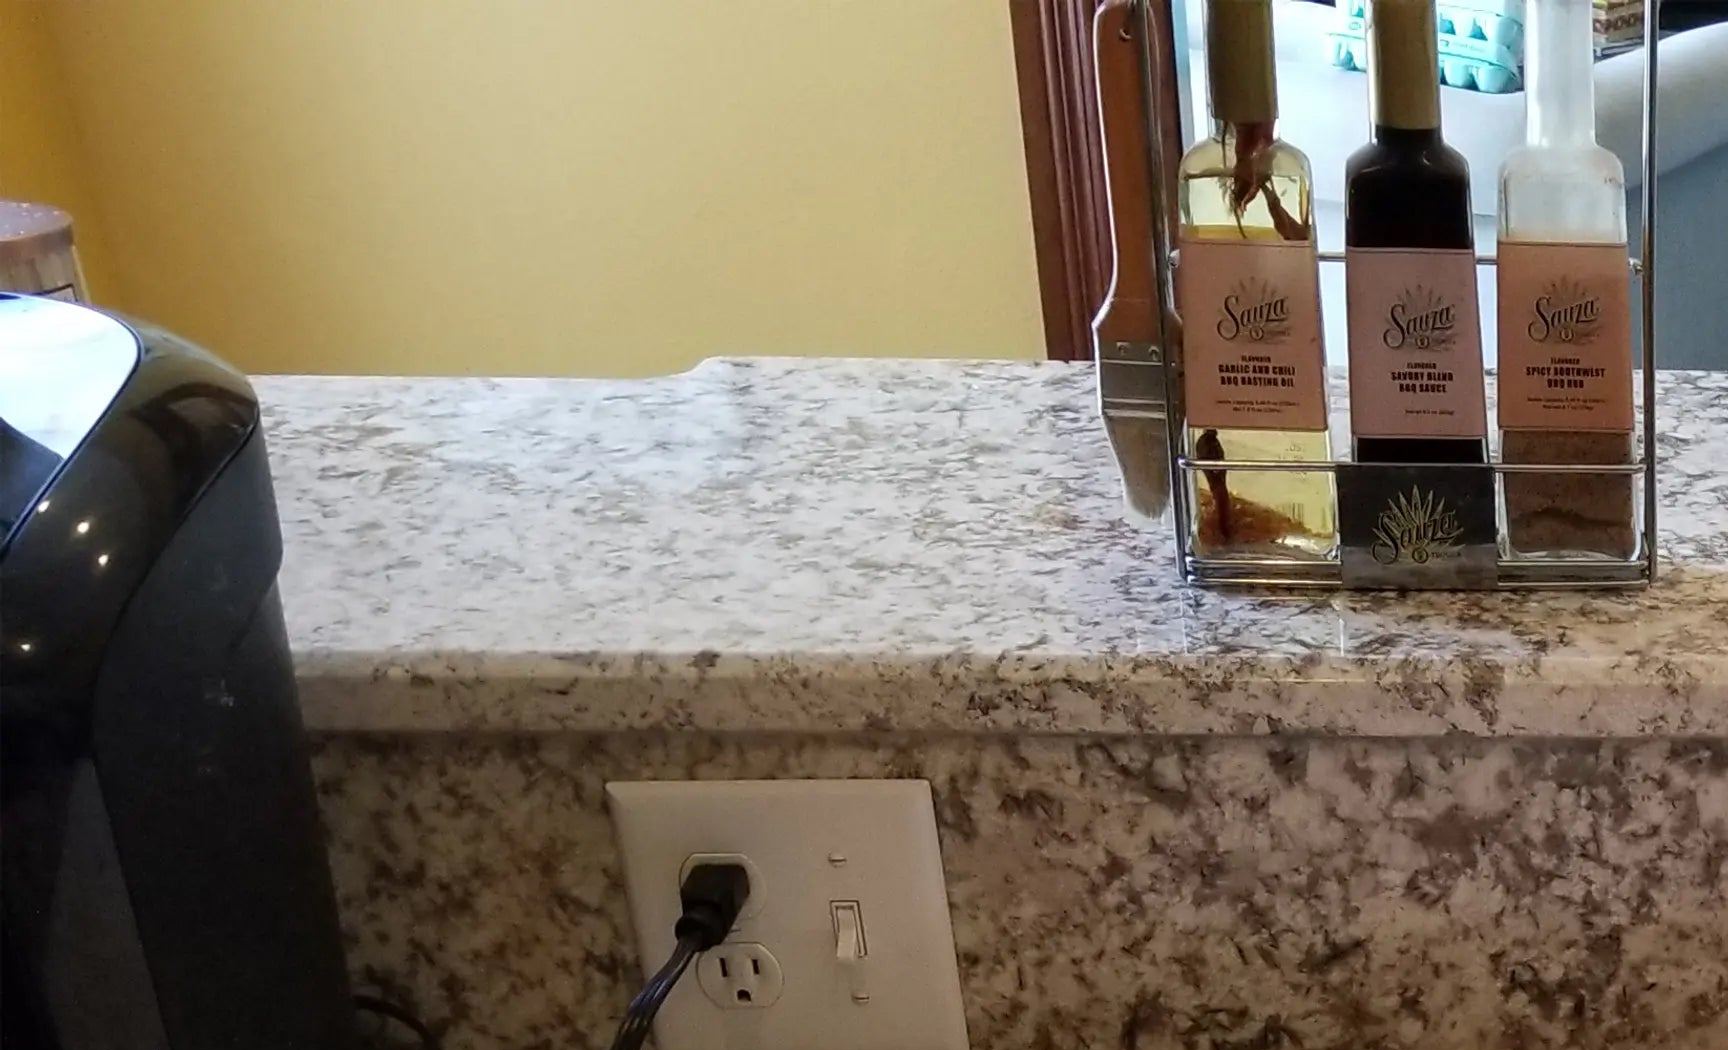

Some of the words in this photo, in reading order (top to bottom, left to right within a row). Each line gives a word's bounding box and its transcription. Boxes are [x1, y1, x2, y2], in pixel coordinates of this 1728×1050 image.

[1217, 295, 1288, 341] Sauza
[1528, 296, 1599, 342] Sauza
[1383, 303, 1455, 349] Sauza
[1218, 364, 1250, 374] GARLIC
[1252, 365, 1270, 375] AND
[1272, 366, 1295, 376] CHILI
[1391, 371, 1424, 381] SAVORY
[1526, 366, 1551, 376] SPICY
[1553, 366, 1606, 378] SOUTHWEST
[1220, 376, 1239, 386] BBQ
[1241, 377, 1278, 387] BASTING
[1281, 377, 1295, 388] OIL
[1399, 383, 1417, 393] BBQ
[1419, 384, 1447, 393] SAUCE
[1372, 510, 1458, 565] Sauza
